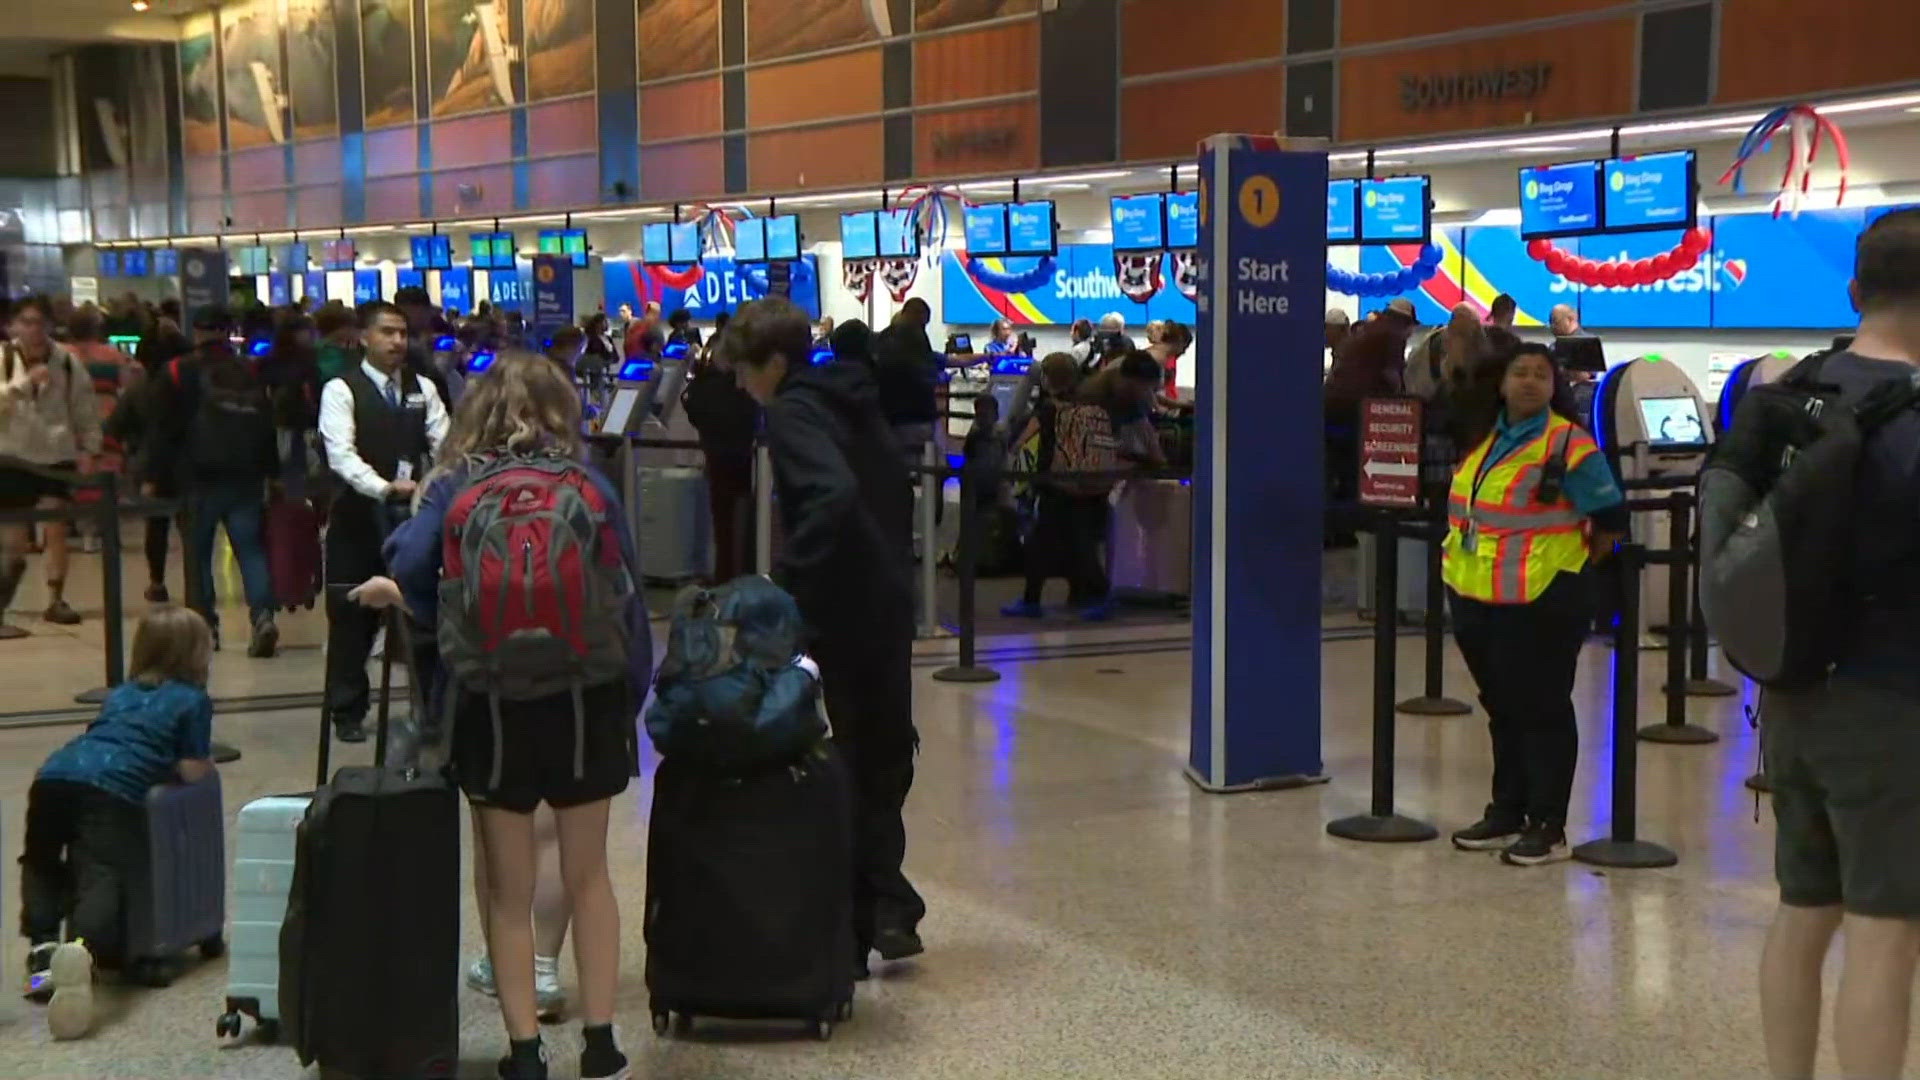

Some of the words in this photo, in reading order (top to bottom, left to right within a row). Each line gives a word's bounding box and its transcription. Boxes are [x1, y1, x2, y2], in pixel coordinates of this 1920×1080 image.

[1399, 63, 1552, 113] SOUTHWEST
[1253, 188, 1263, 216] 1
[1237, 256, 1289, 282] Start
[1237, 289, 1289, 315] Here
[1370, 403, 1412, 415] GENERAL
[1368, 422, 1414, 435] SECURITY
[1363, 440, 1419, 453] SCREENING
